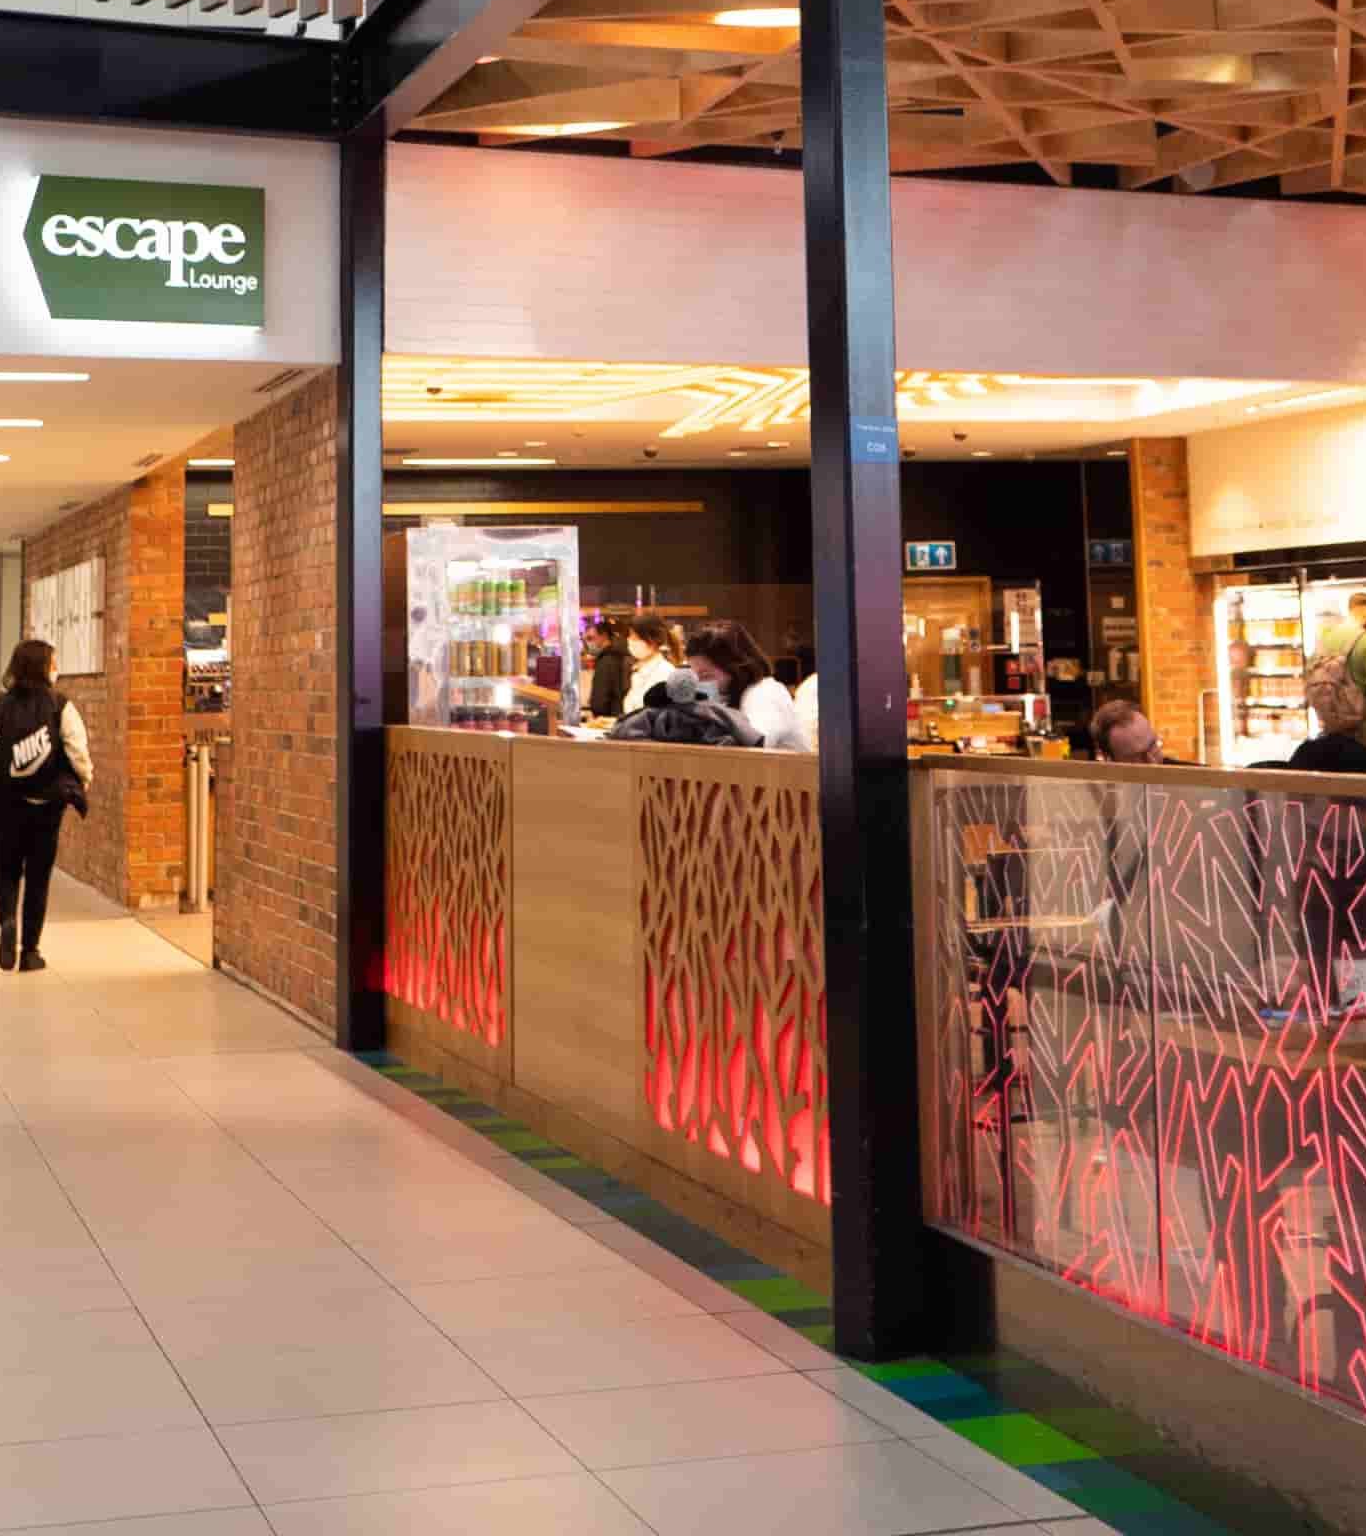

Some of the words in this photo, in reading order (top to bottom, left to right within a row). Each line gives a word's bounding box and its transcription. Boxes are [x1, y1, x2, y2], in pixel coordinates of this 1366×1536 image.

[41, 213, 247, 288] escape
[189, 267, 259, 296] Lounge
[12, 725, 53, 769] NIKE
